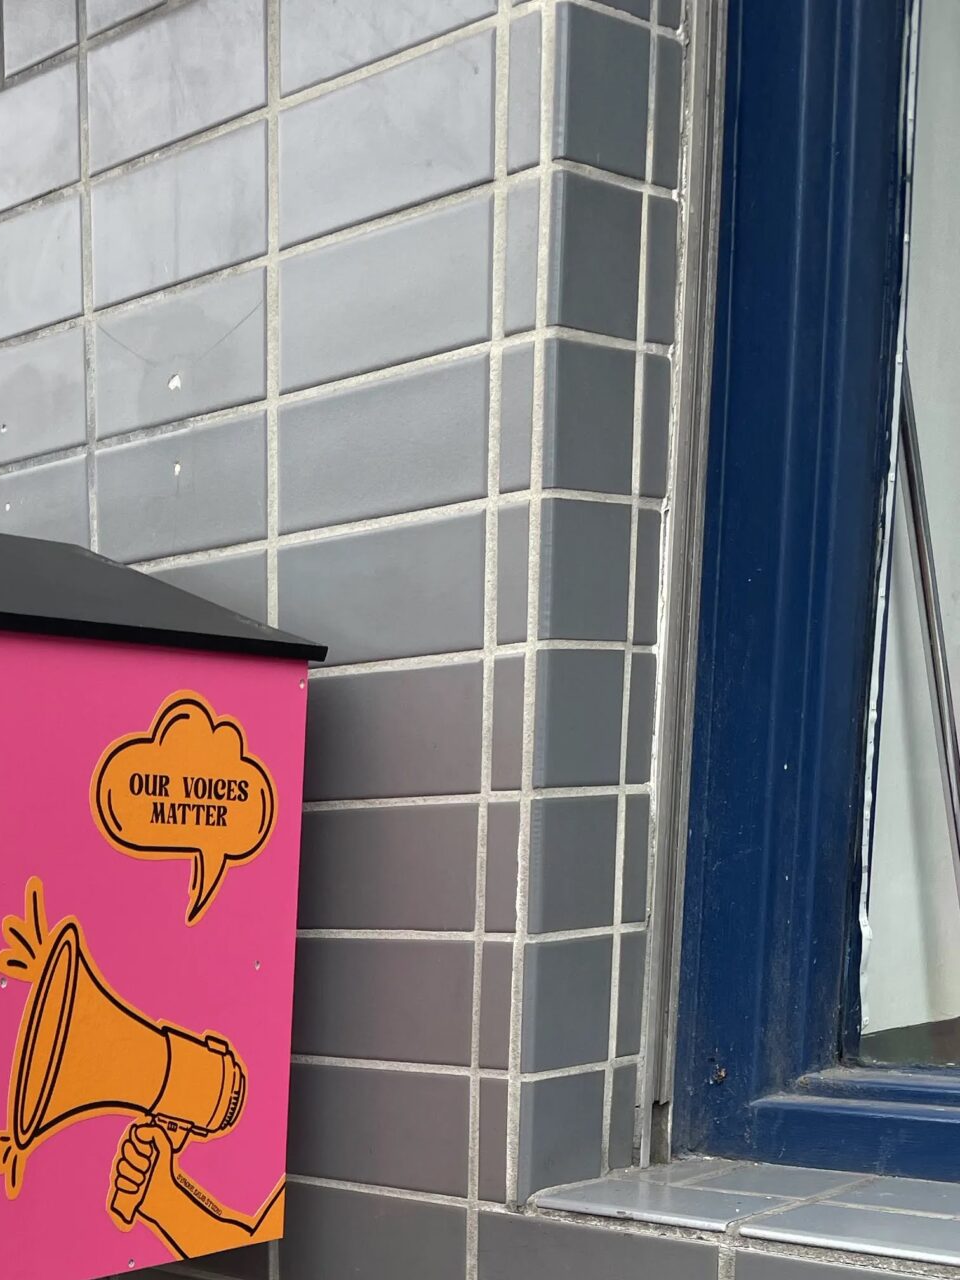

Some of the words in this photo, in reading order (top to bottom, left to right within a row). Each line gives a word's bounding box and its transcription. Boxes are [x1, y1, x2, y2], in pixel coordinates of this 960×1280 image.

[129, 772, 170, 797] OUR
[182, 776, 249, 802] VOICES
[150, 801, 228, 827] MATTER
